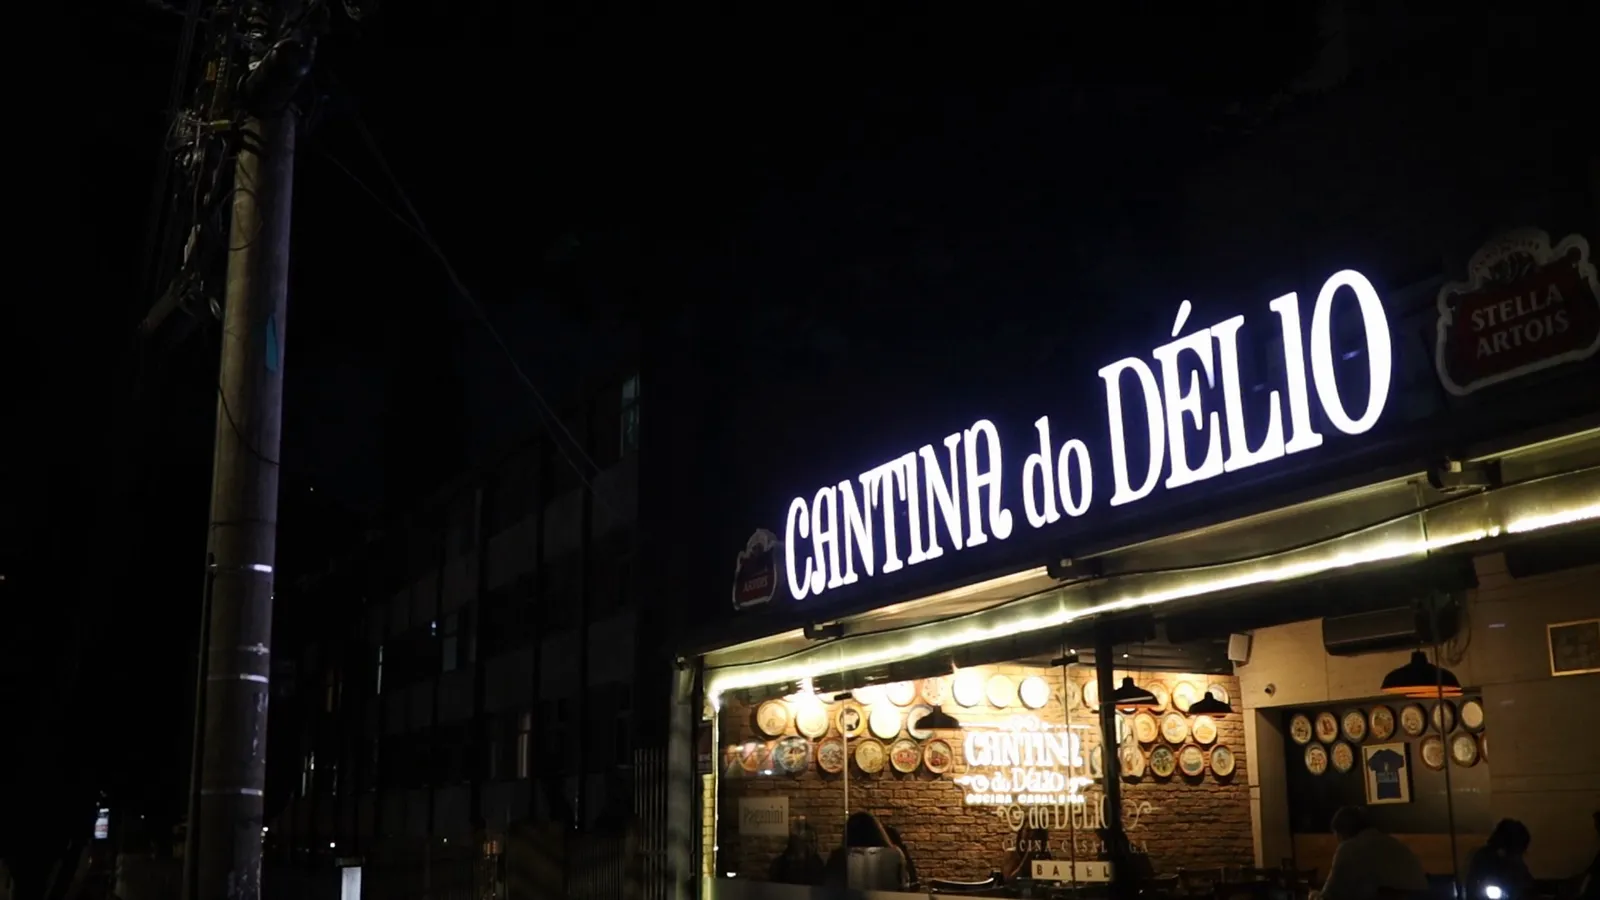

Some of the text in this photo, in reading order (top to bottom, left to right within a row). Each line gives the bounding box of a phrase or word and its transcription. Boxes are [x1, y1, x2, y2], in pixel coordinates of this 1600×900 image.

[1471, 283, 1564, 332] STELLA
[1476, 310, 1570, 360] ARTOIS
[784, 269, 1392, 600] CANTINA do DÉLIO
[1036, 863, 1111, 879] BATEL
